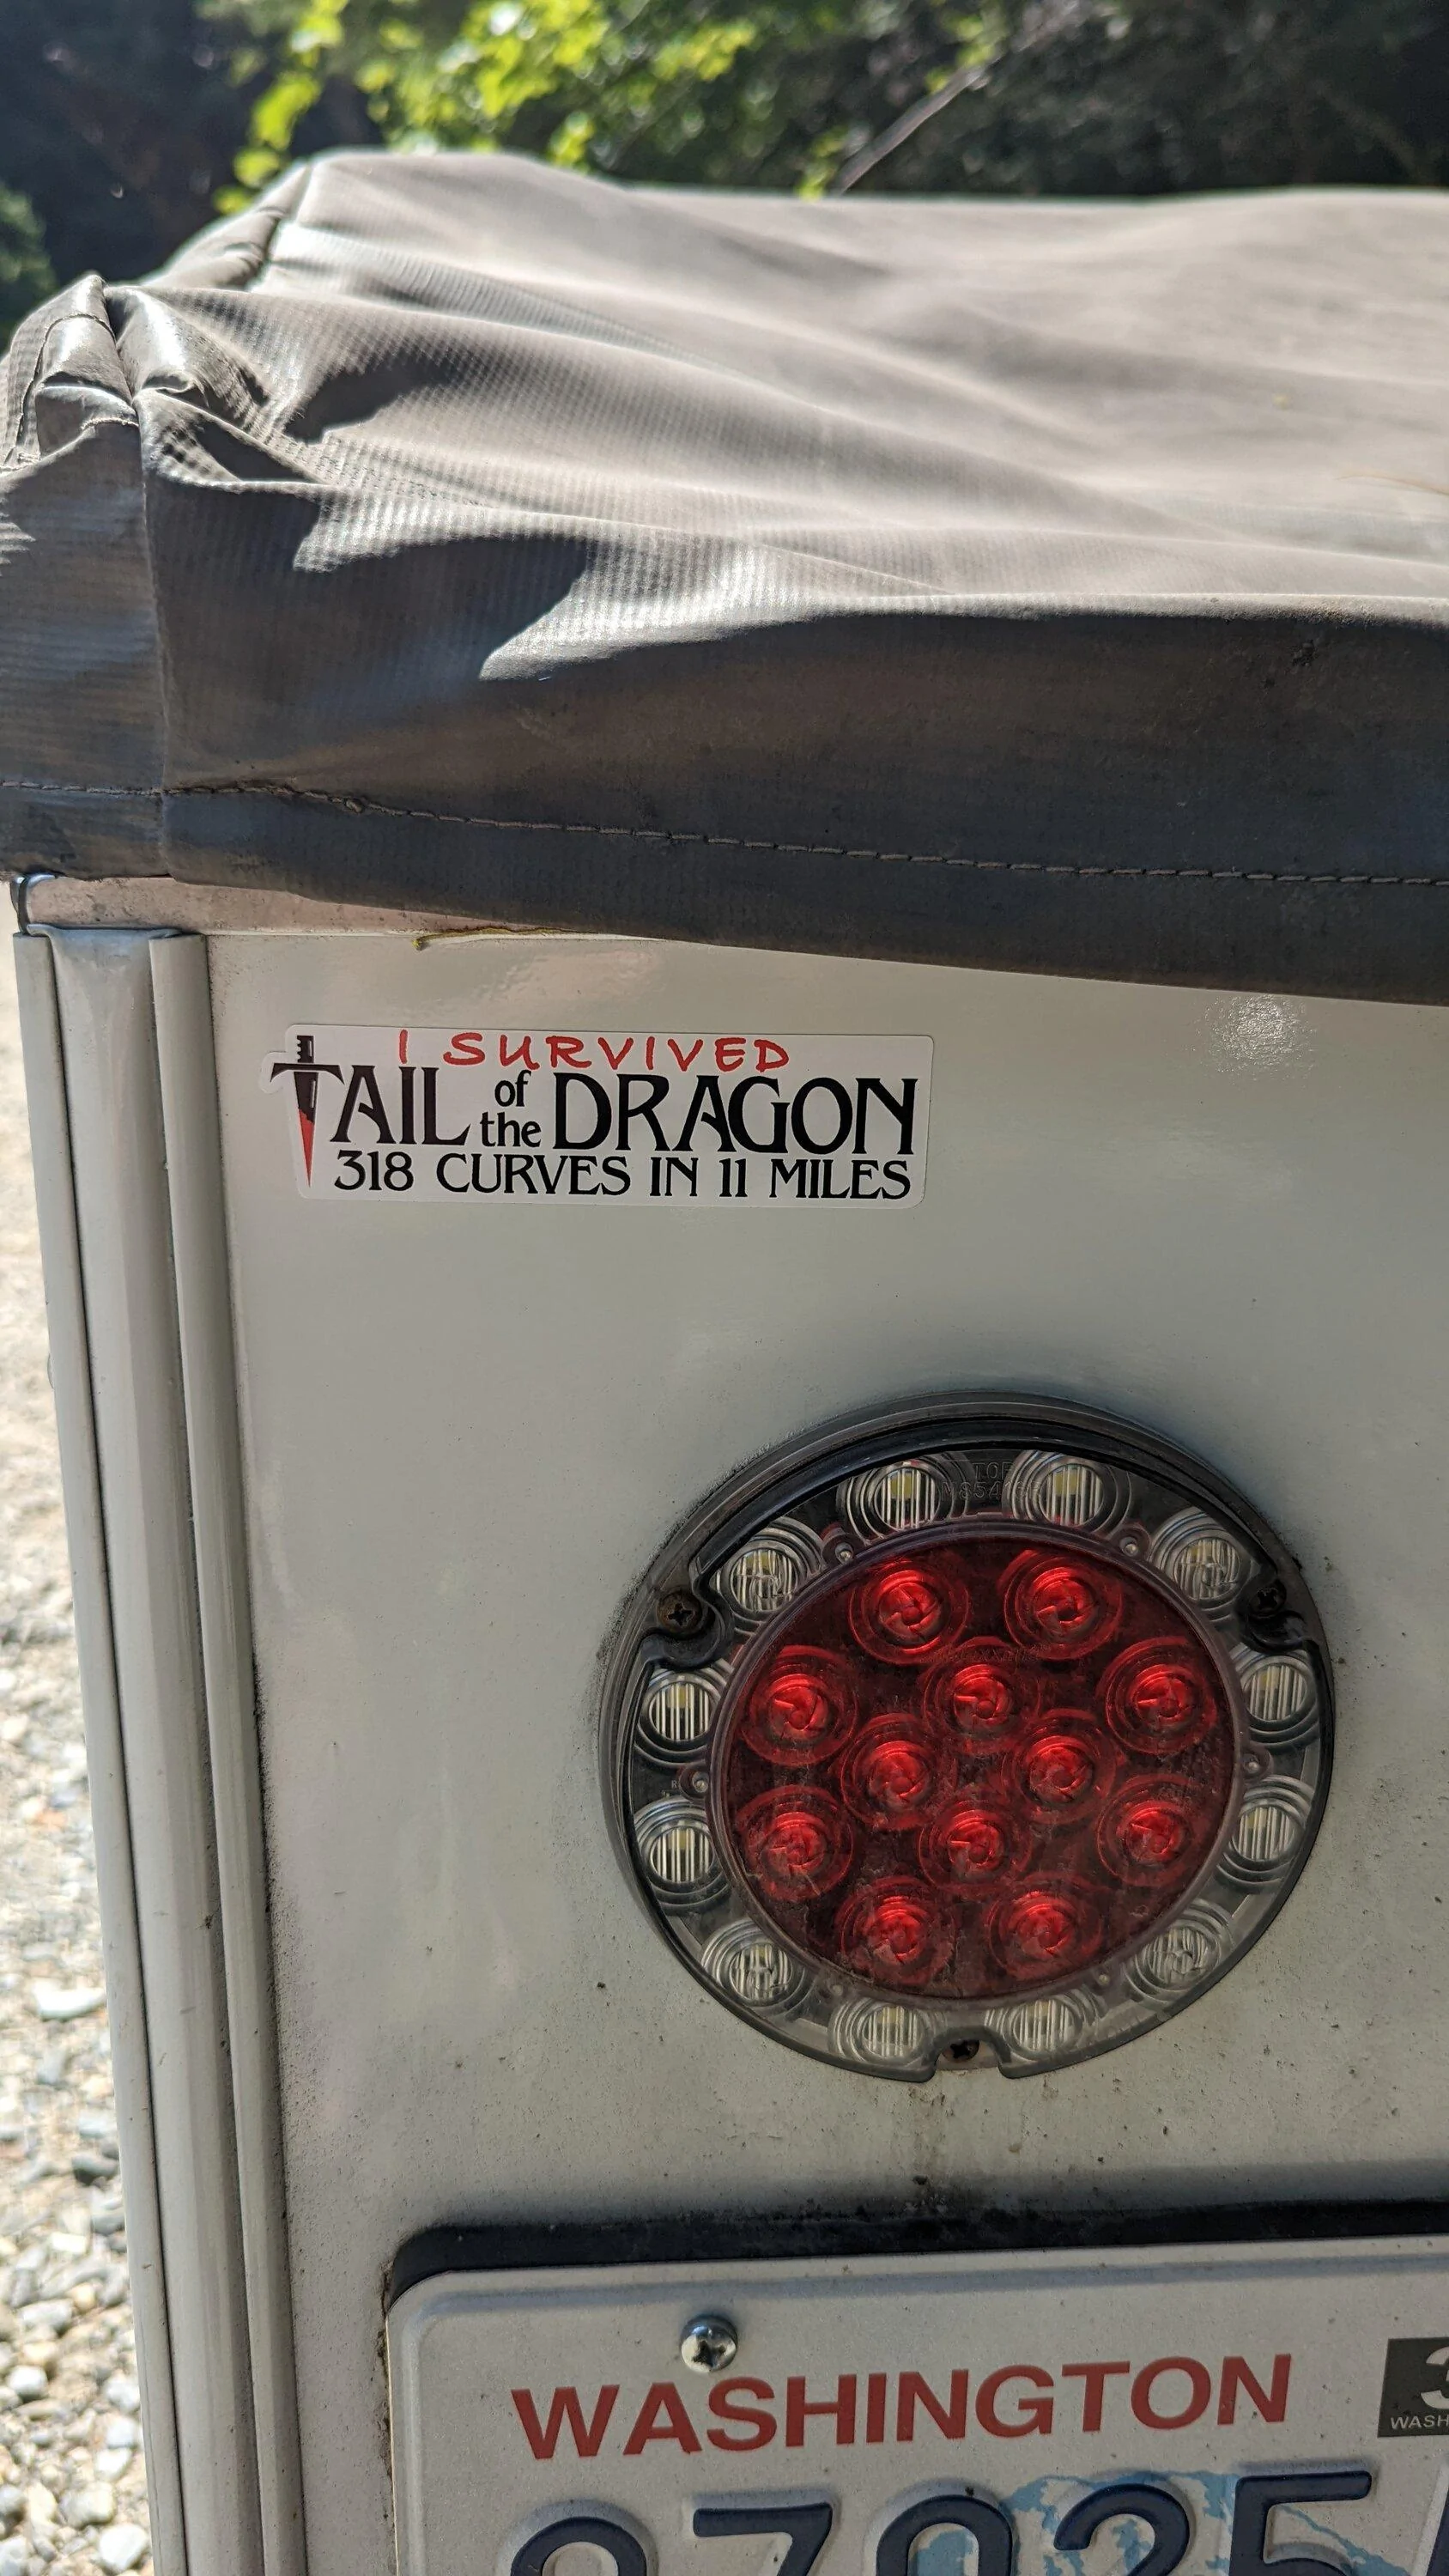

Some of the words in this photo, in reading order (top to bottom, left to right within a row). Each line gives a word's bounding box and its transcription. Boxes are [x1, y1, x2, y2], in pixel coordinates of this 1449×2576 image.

[397, 1029, 409, 1066] I
[441, 1030, 791, 1073] SURVIVED
[270, 1036, 471, 1187] TAIL
[494, 1069, 533, 1109] of
[551, 1072, 919, 1156] DRAGON
[479, 1110, 543, 1148] the
[333, 1149, 415, 1193] 318
[435, 1151, 632, 1197] CURVES
[648, 1156, 700, 1198] IN
[718, 1157, 749, 1199] 11
[767, 1157, 912, 1201] MILES
[512, 2354, 1292, 2460] WASHINGTON
